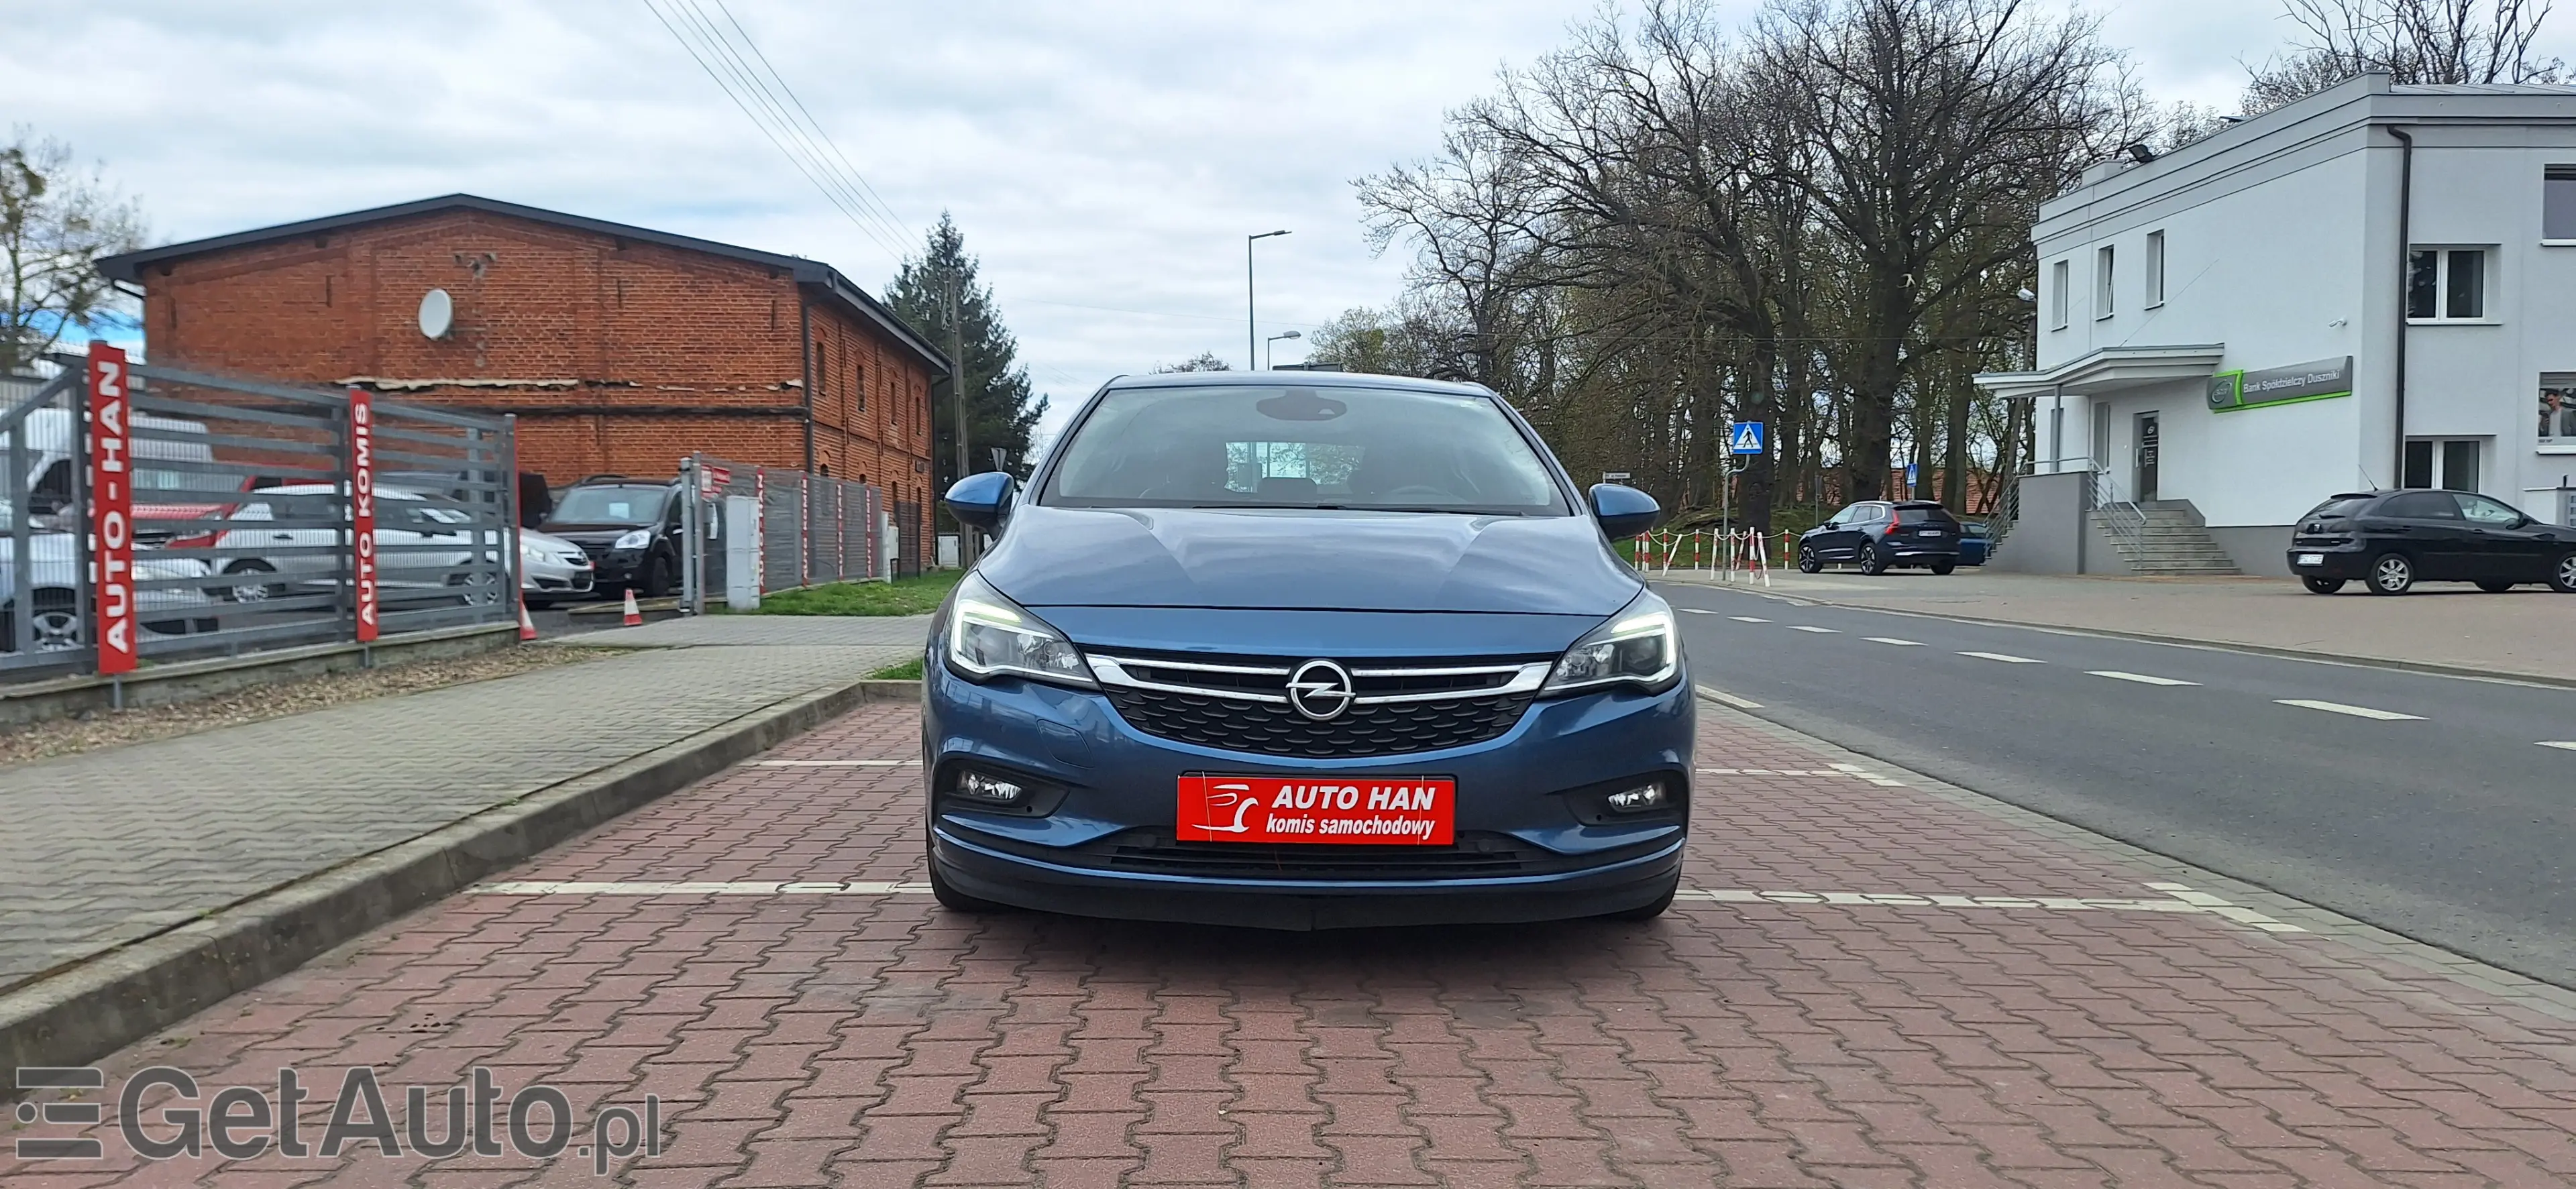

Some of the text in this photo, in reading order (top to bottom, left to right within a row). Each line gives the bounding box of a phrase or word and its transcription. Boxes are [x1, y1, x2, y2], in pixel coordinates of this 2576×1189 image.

[2243, 383, 2261, 394] Bank
[2261, 376, 2306, 392] Spółdzielczy
[2307, 370, 2341, 384] Duszniki
[98, 361, 123, 473] HAN
[354, 402, 374, 626] AUTO KOMIS
[103, 510, 129, 654] AUTO
[1265, 813, 1436, 840] komis samochodowy
[1271, 785, 1436, 811] AUTO HAN
